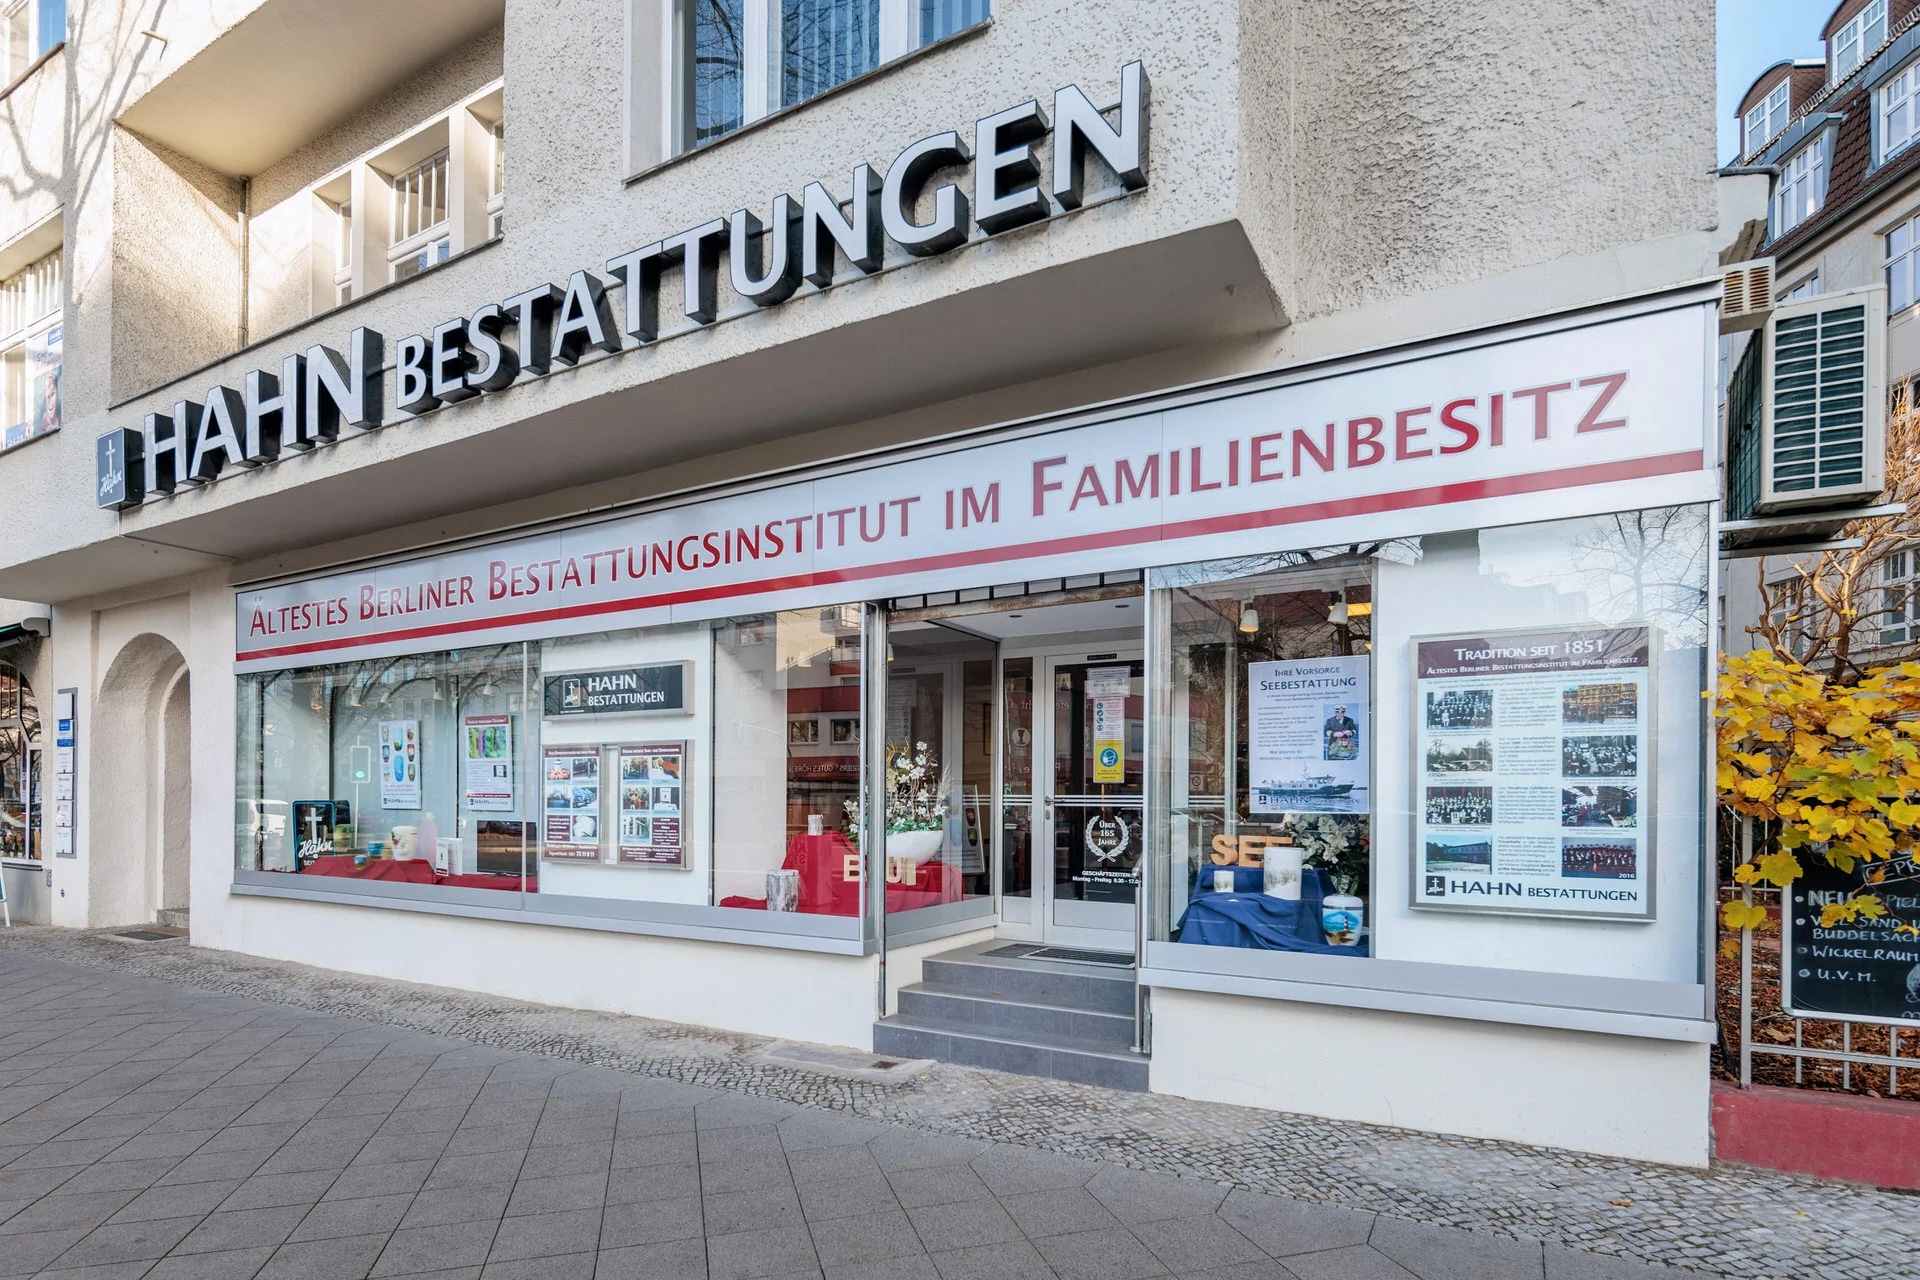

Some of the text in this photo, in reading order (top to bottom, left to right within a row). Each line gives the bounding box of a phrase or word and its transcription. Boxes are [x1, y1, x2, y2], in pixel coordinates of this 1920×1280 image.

[143, 59, 1149, 495] HAHN BESTATTUNGEN
[249, 369, 1629, 637] ÄLTESTES BERLINER BESTATTUNGSINSTITUT IM FAMILIENBESITZ
[1454, 640, 1603, 661] TRADITION SEIT 1851
[1296, 666, 1341, 676] VORSORGE
[1460, 664, 1490, 673] BERLINER
[1492, 661, 1569, 671] BESTATTUNGSINSTITUT
[588, 674, 637, 692] HAHN
[1260, 677, 1357, 691] SEEBESTATTUNG
[588, 691, 665, 706] BESTATTUNGEN
[1100, 829, 1115, 837] 165
[298, 838, 334, 858] Hahn
[1451, 880, 1638, 901] HAHN BESTATTUNGEN
